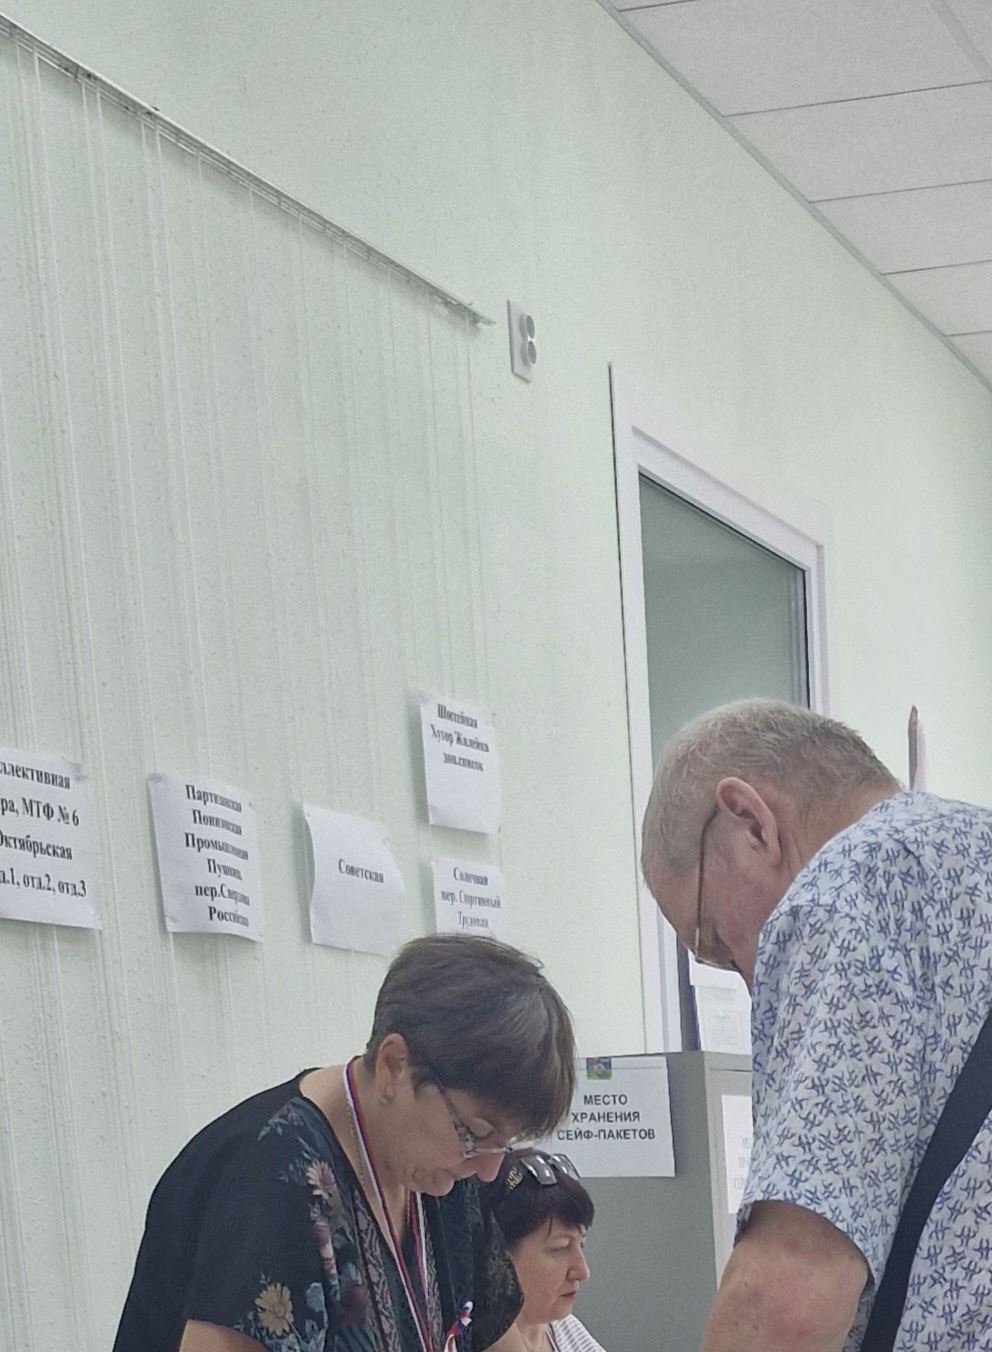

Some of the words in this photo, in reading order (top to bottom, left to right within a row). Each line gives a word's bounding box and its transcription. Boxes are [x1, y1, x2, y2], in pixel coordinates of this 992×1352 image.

[430, 723, 454, 747] Хутор
[22, 797, 54, 821] МТФ
[57, 804, 70, 825] №
[72, 808, 80, 827] 6
[338, 858, 384, 884] Советская
[58, 880, 87, 898] отд.3
[583, 1093, 628, 1106] МЕСТО
[571, 1111, 641, 1124] ХРАНЕНИЯ
[557, 1127, 656, 1141] СЕЙФ-ПАКЕТОВ
